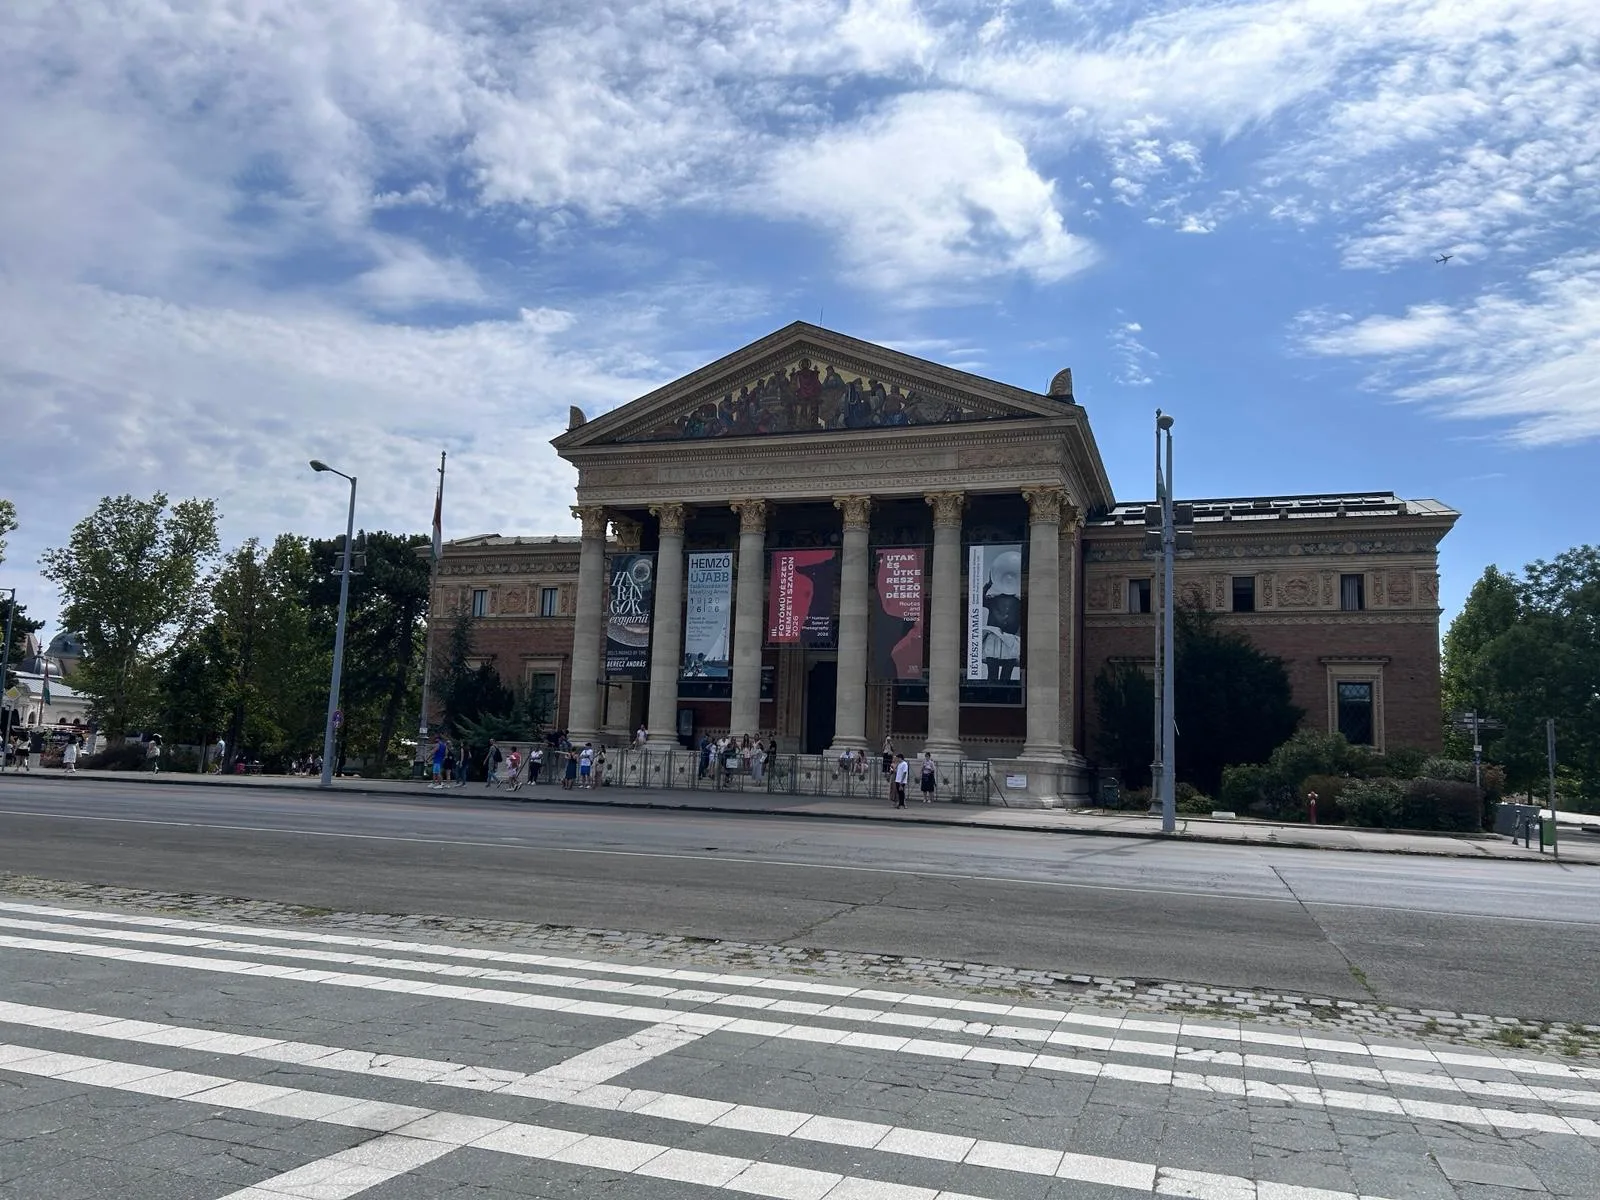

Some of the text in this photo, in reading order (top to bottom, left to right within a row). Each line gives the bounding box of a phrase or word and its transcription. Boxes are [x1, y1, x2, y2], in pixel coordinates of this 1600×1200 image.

[688, 467, 734, 479] MAGYAR
[886, 560, 900, 569] ÉS
[893, 567, 921, 576] ÚTKE
[610, 571, 635, 587] HA
[690, 570, 729, 583] ÚJABB
[617, 585, 644, 600] RAN
[893, 583, 921, 591] TEZŐ
[778, 556, 787, 637] FOTÓMŰVÉSZETI
[886, 590, 920, 599] DÉSEK
[610, 599, 642, 616] GOK
[785, 596, 793, 637] NEMZETI
[971, 608, 979, 639] TAMÁS
[607, 660, 646, 668] BERECZ ANDRÁS
[970, 641, 978, 676] RÉVÉSZ
